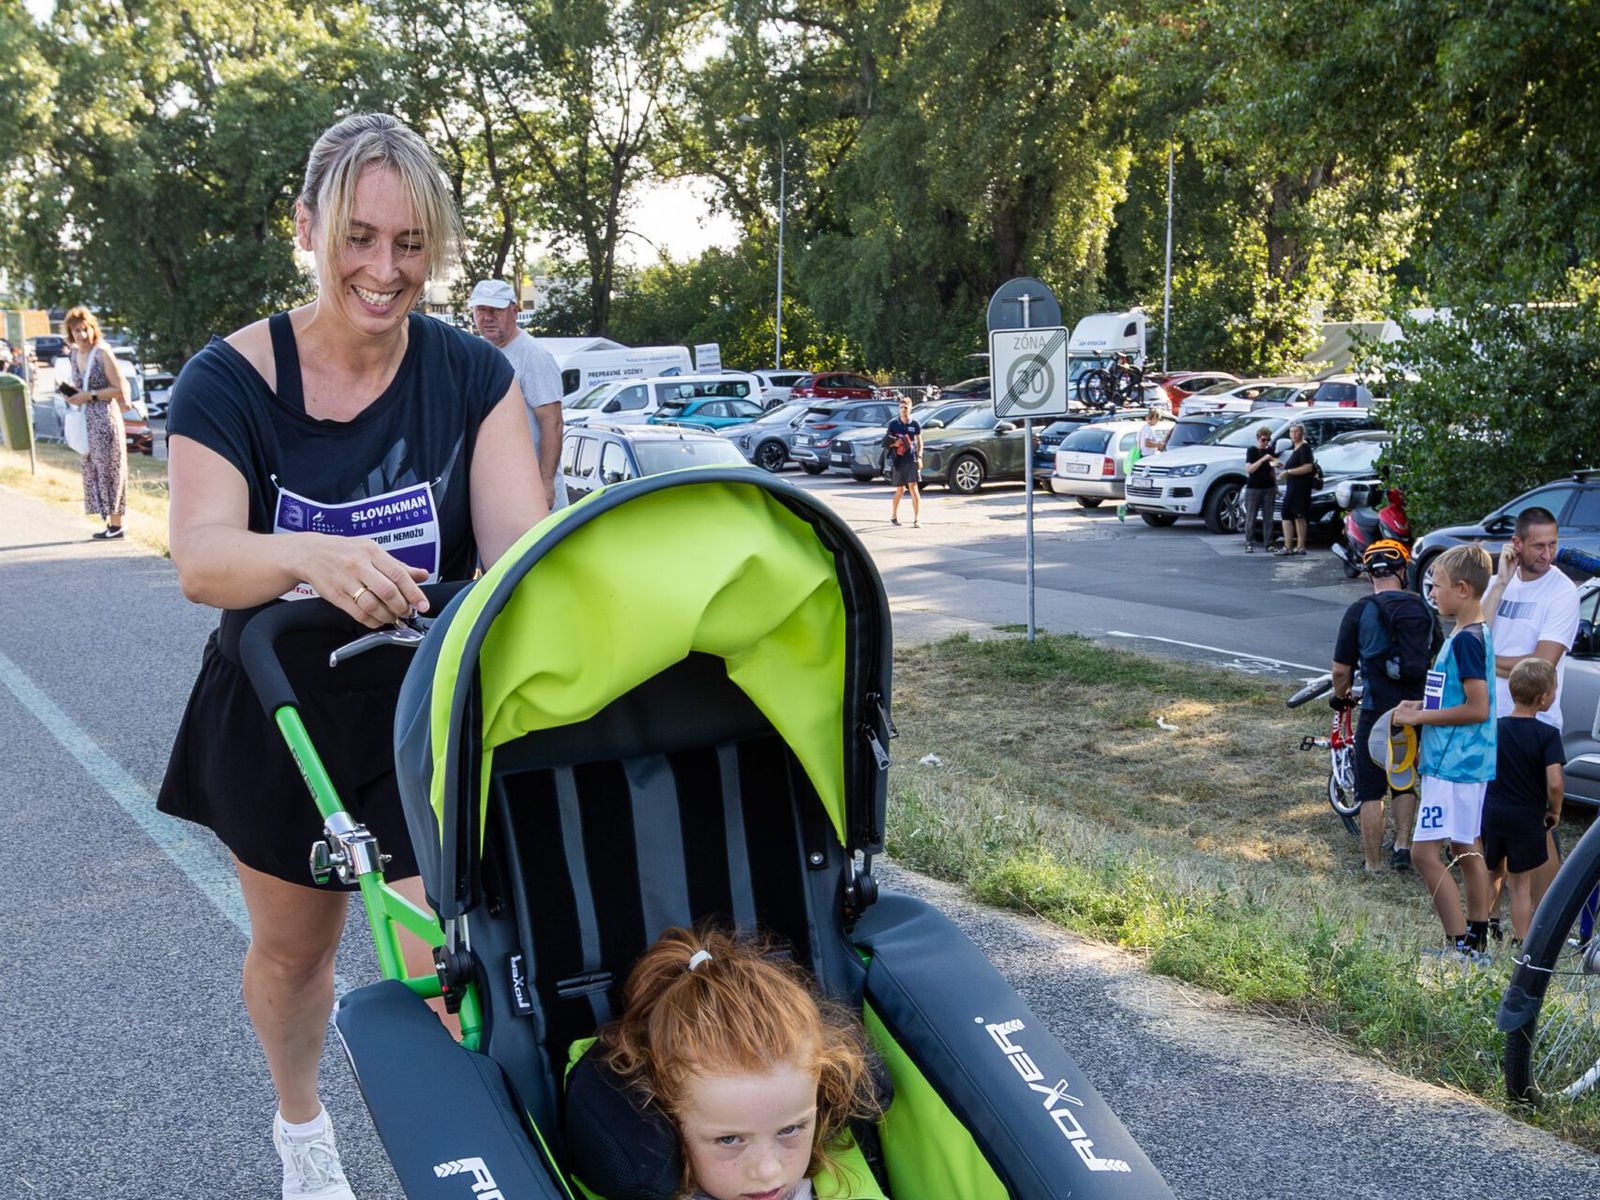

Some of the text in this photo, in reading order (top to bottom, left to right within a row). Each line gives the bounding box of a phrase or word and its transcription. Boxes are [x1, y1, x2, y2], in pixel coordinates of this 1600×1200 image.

[1013, 333, 1046, 350] ZÓNA
[1017, 368, 1044, 395] 30
[351, 495, 427, 522] SLOVAKMAN
[352, 509, 428, 530] TRIATHLON
[1421, 806, 1443, 829] 22
